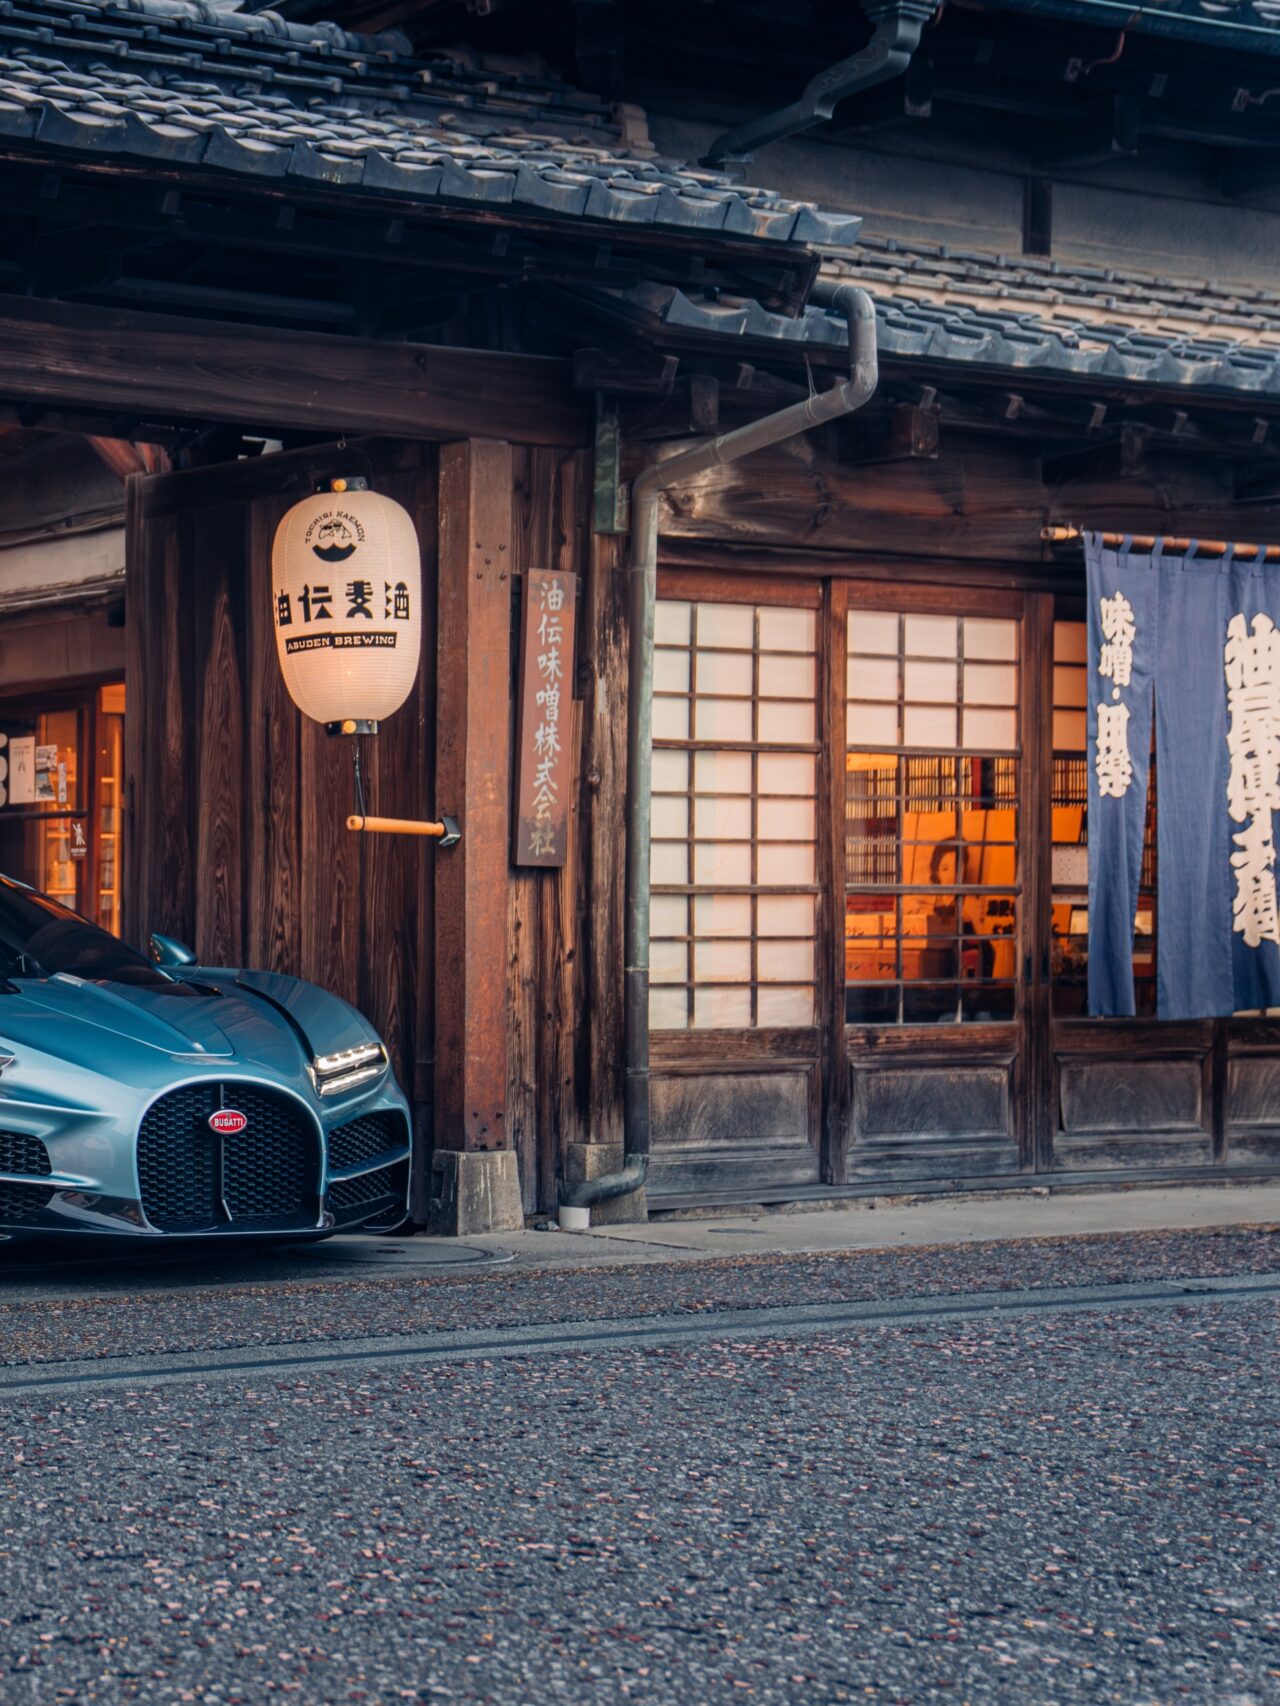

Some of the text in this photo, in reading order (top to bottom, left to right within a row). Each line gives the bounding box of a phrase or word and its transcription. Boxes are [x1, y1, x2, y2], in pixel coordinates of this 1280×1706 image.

[274, 580, 410, 627] 油伝麦酒
[287, 634, 395, 651] ABUDEN BREWING
[527, 578, 565, 857] 油伝味噌株式会社
[214, 1117, 244, 1127] BUGATTI
